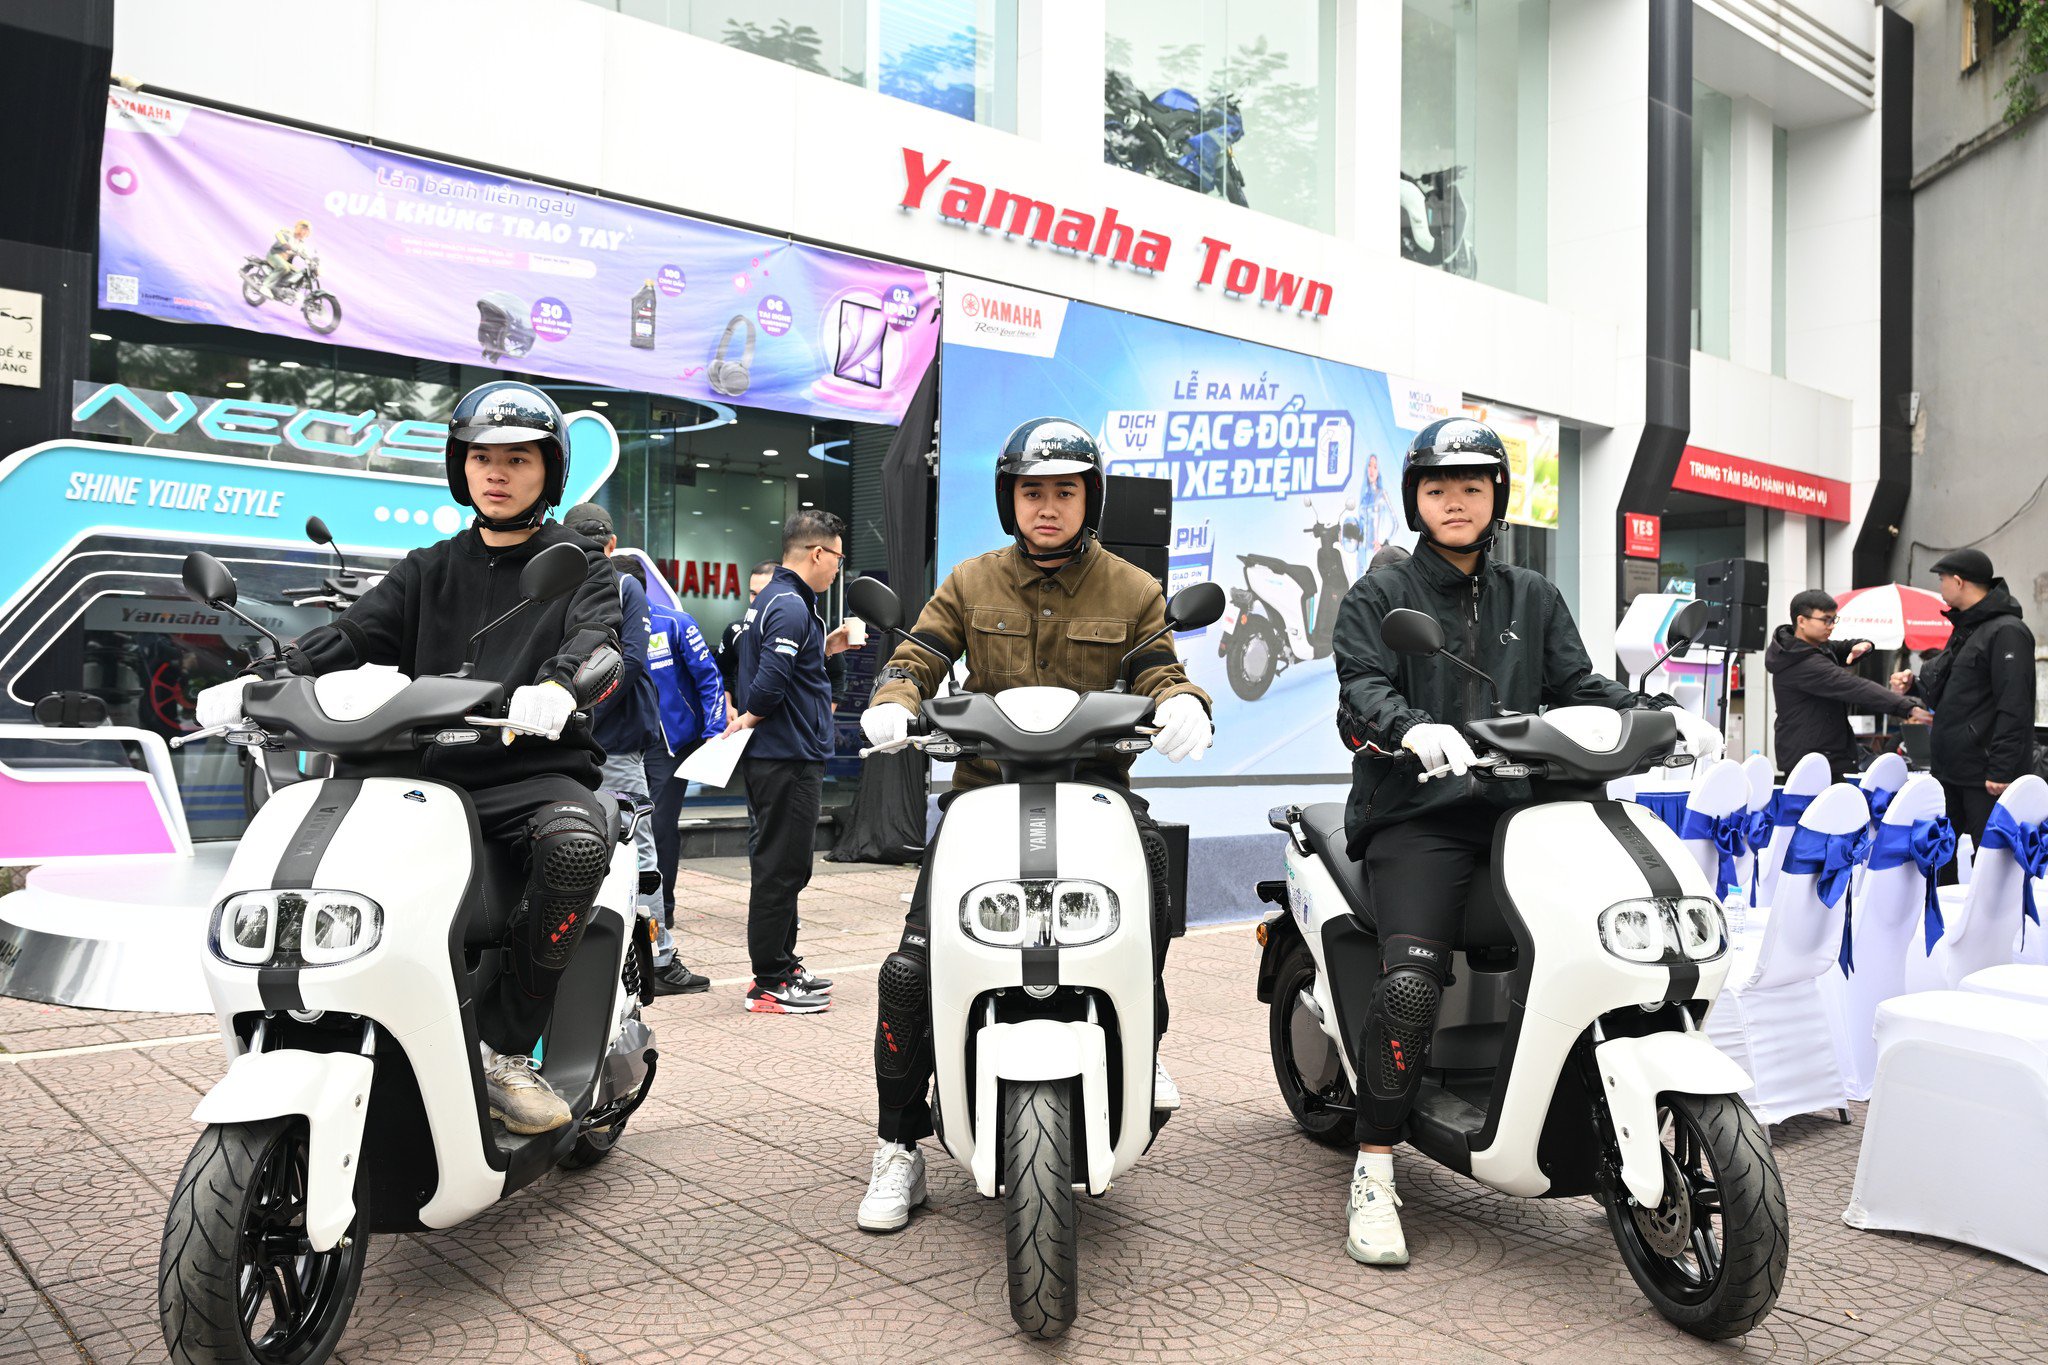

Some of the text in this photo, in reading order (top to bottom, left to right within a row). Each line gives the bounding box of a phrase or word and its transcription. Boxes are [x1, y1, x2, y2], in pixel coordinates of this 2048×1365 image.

[122, 99, 171, 121] YAMAHA
[424, 172, 478, 200] bánh
[485, 179, 519, 206] liền
[526, 194, 576, 217] ngay
[499, 215, 572, 243] TRAO
[578, 226, 627, 251] TAY
[899, 147, 1333, 316] Yamaha Town
[540, 302, 563, 319] 30
[892, 288, 910, 303] 03
[981, 297, 1042, 329] YAMAHA
[0, 360, 28, 374] ÀNG
[18, 350, 33, 360] XE
[1174, 370, 1280, 400] LỄ RA MẮT
[1118, 414, 1156, 434] DỊCH
[1167, 413, 1234, 457] SẠC
[1030, 441, 1063, 450] YAMAHA
[1125, 433, 1148, 452] VỤ
[1183, 459, 1228, 498] XE
[1230, 450, 1315, 498] ĐIỆN
[1690, 461, 1828, 507] TRUNG TÂM BẢO HÀNH VÀ DỊCH VỤ
[65, 471, 285, 518] SHINE YOUR STYLE
[1176, 519, 1210, 549] PHÍ
[1632, 518, 1654, 537] YES
[1172, 570, 1203, 581] GIAO PIN
[121, 607, 220, 626] Yamaha
[1854, 616, 1894, 625] YAMAHA
[293, 805, 339, 858] YAMAHA
[1029, 807, 1047, 852] YAMAHA
[551, 912, 578, 943] LS2
[1391, 1039, 1406, 1071] LS2
